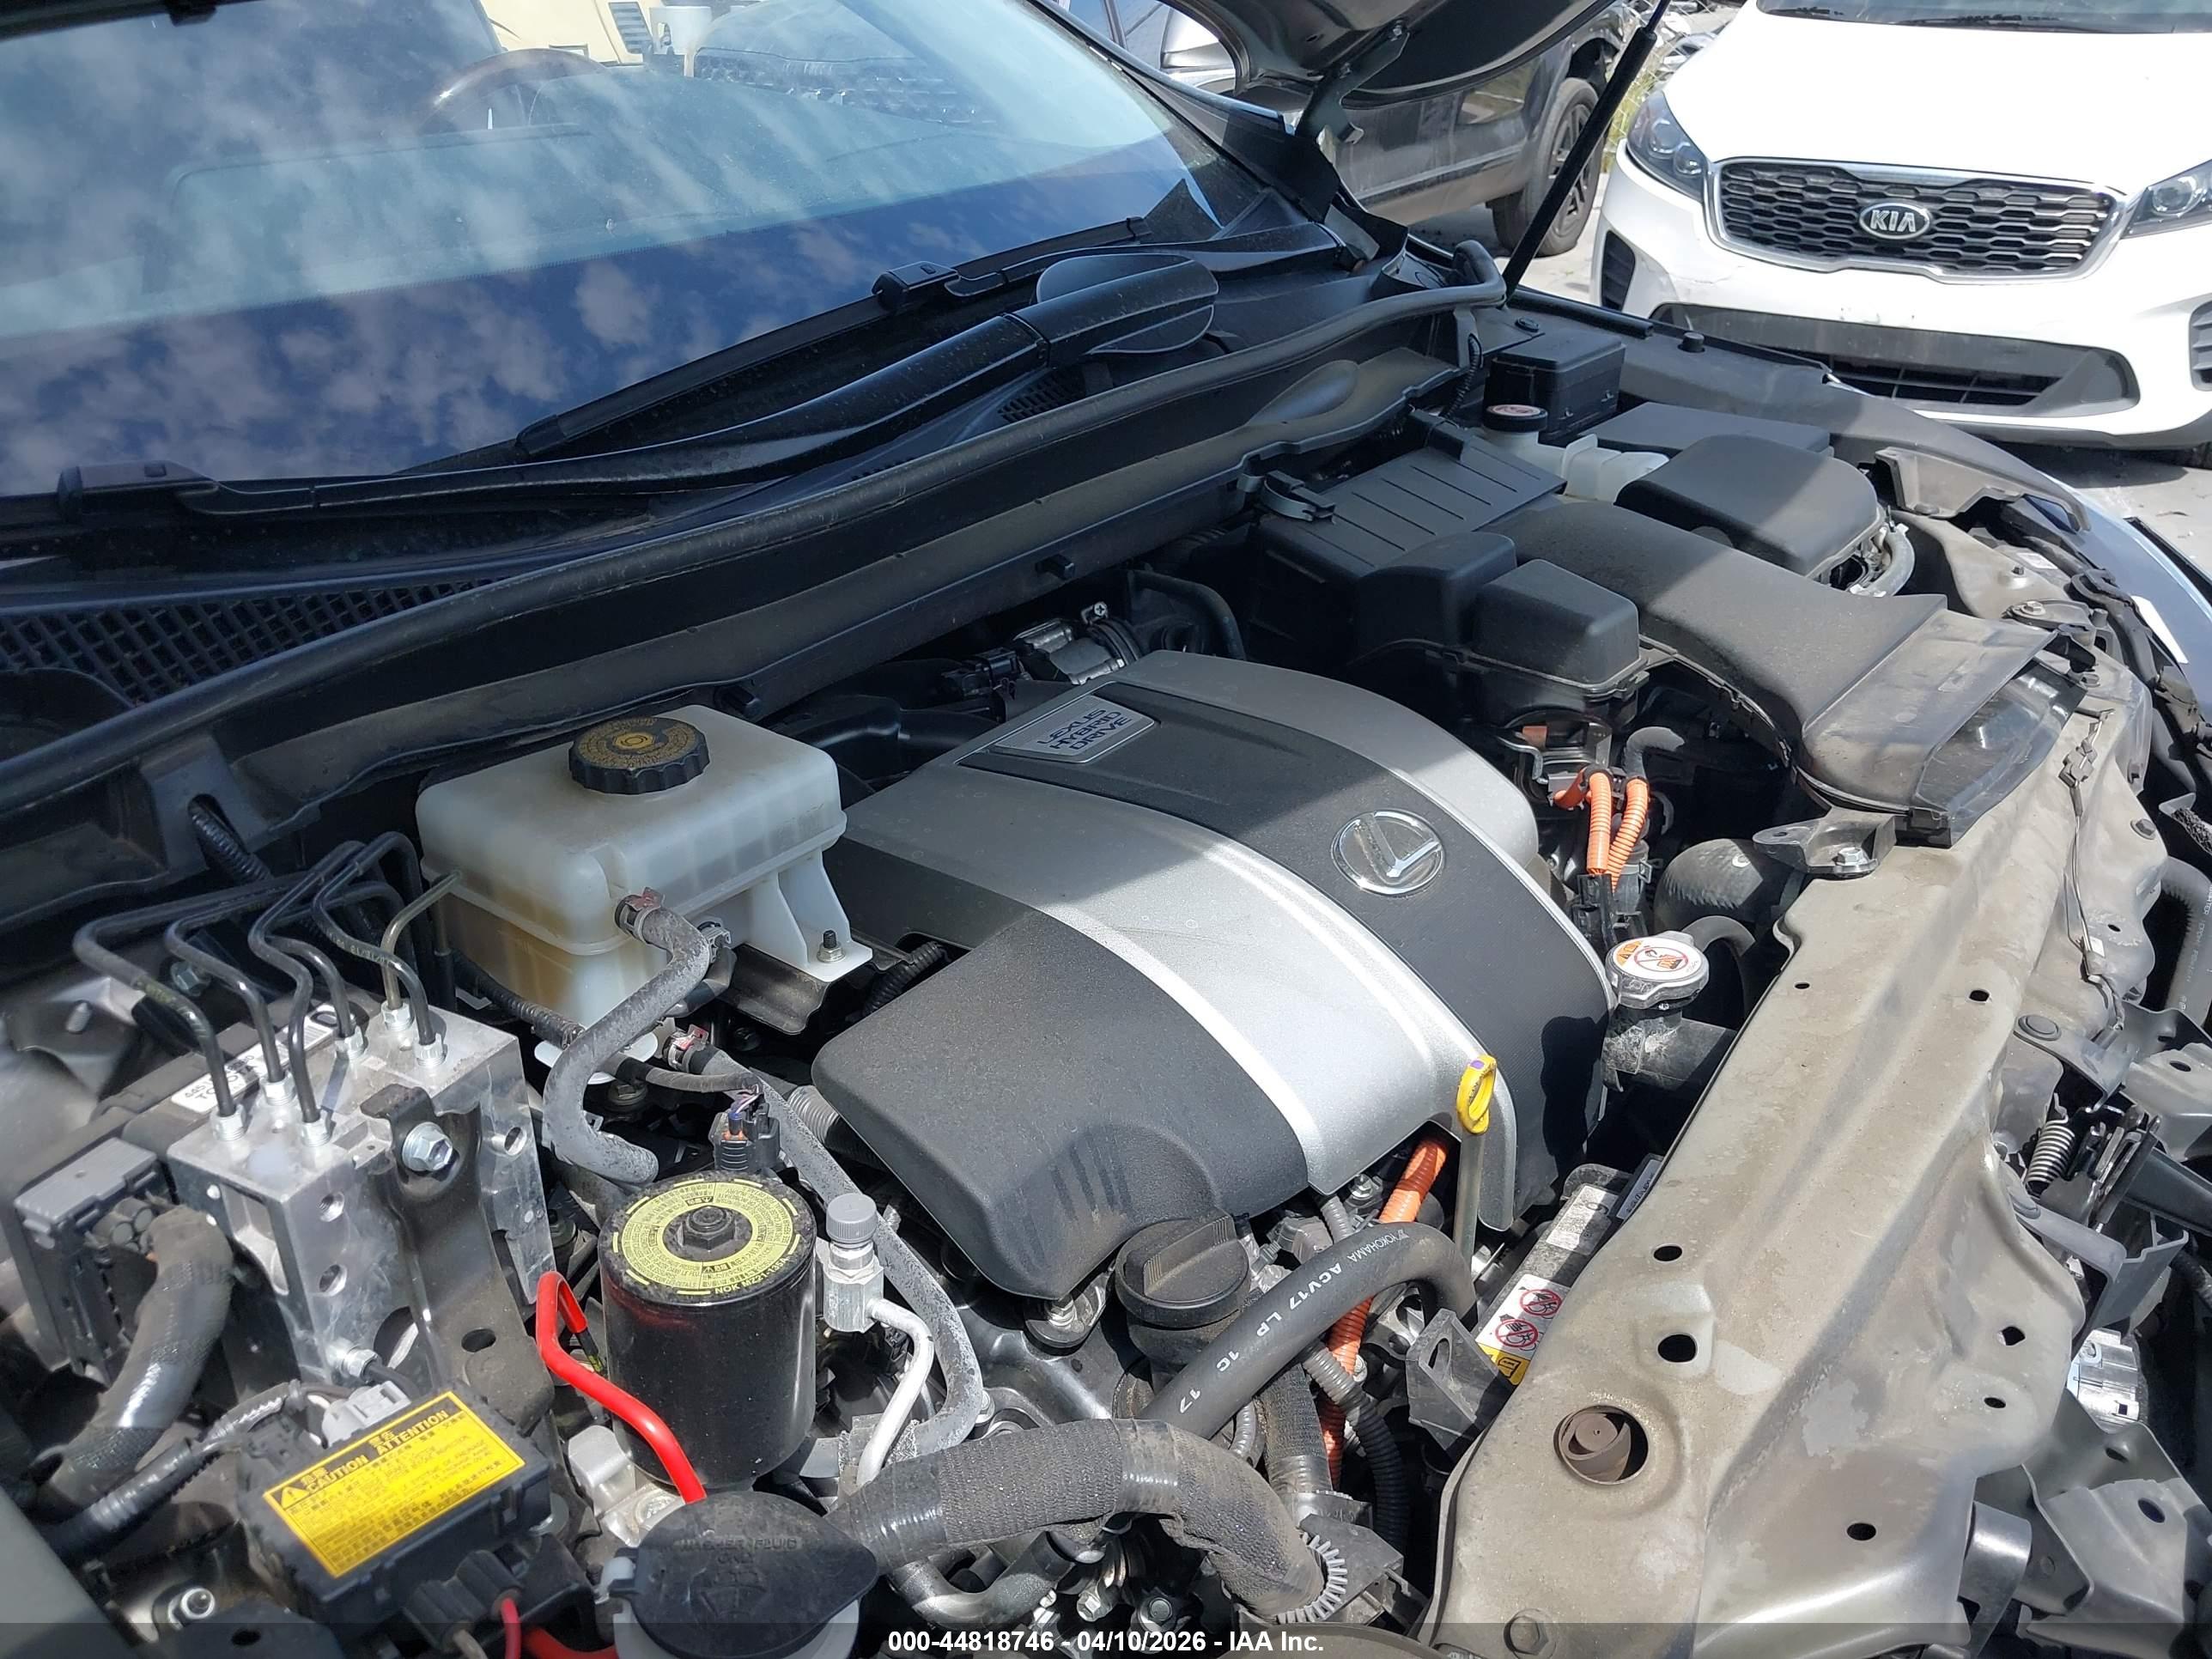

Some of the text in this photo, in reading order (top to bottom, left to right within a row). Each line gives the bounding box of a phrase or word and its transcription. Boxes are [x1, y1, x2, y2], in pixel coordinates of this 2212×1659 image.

[1870, 210, 1916, 233] KIA
[1037, 709, 1108, 744] LEXUS
[1049, 711, 1122, 750] HYBRID
[1070, 718, 1132, 750] DRIVE
[196, 1065, 257, 1099] TOOTA
[714, 1283, 740, 1295] NOK
[1179, 1232, 1401, 1414] YOKOHAMA ACV17 LP 1C 17
[376, 1410, 450, 1455] ATTENTION
[305, 1455, 369, 1493] CAUTION
